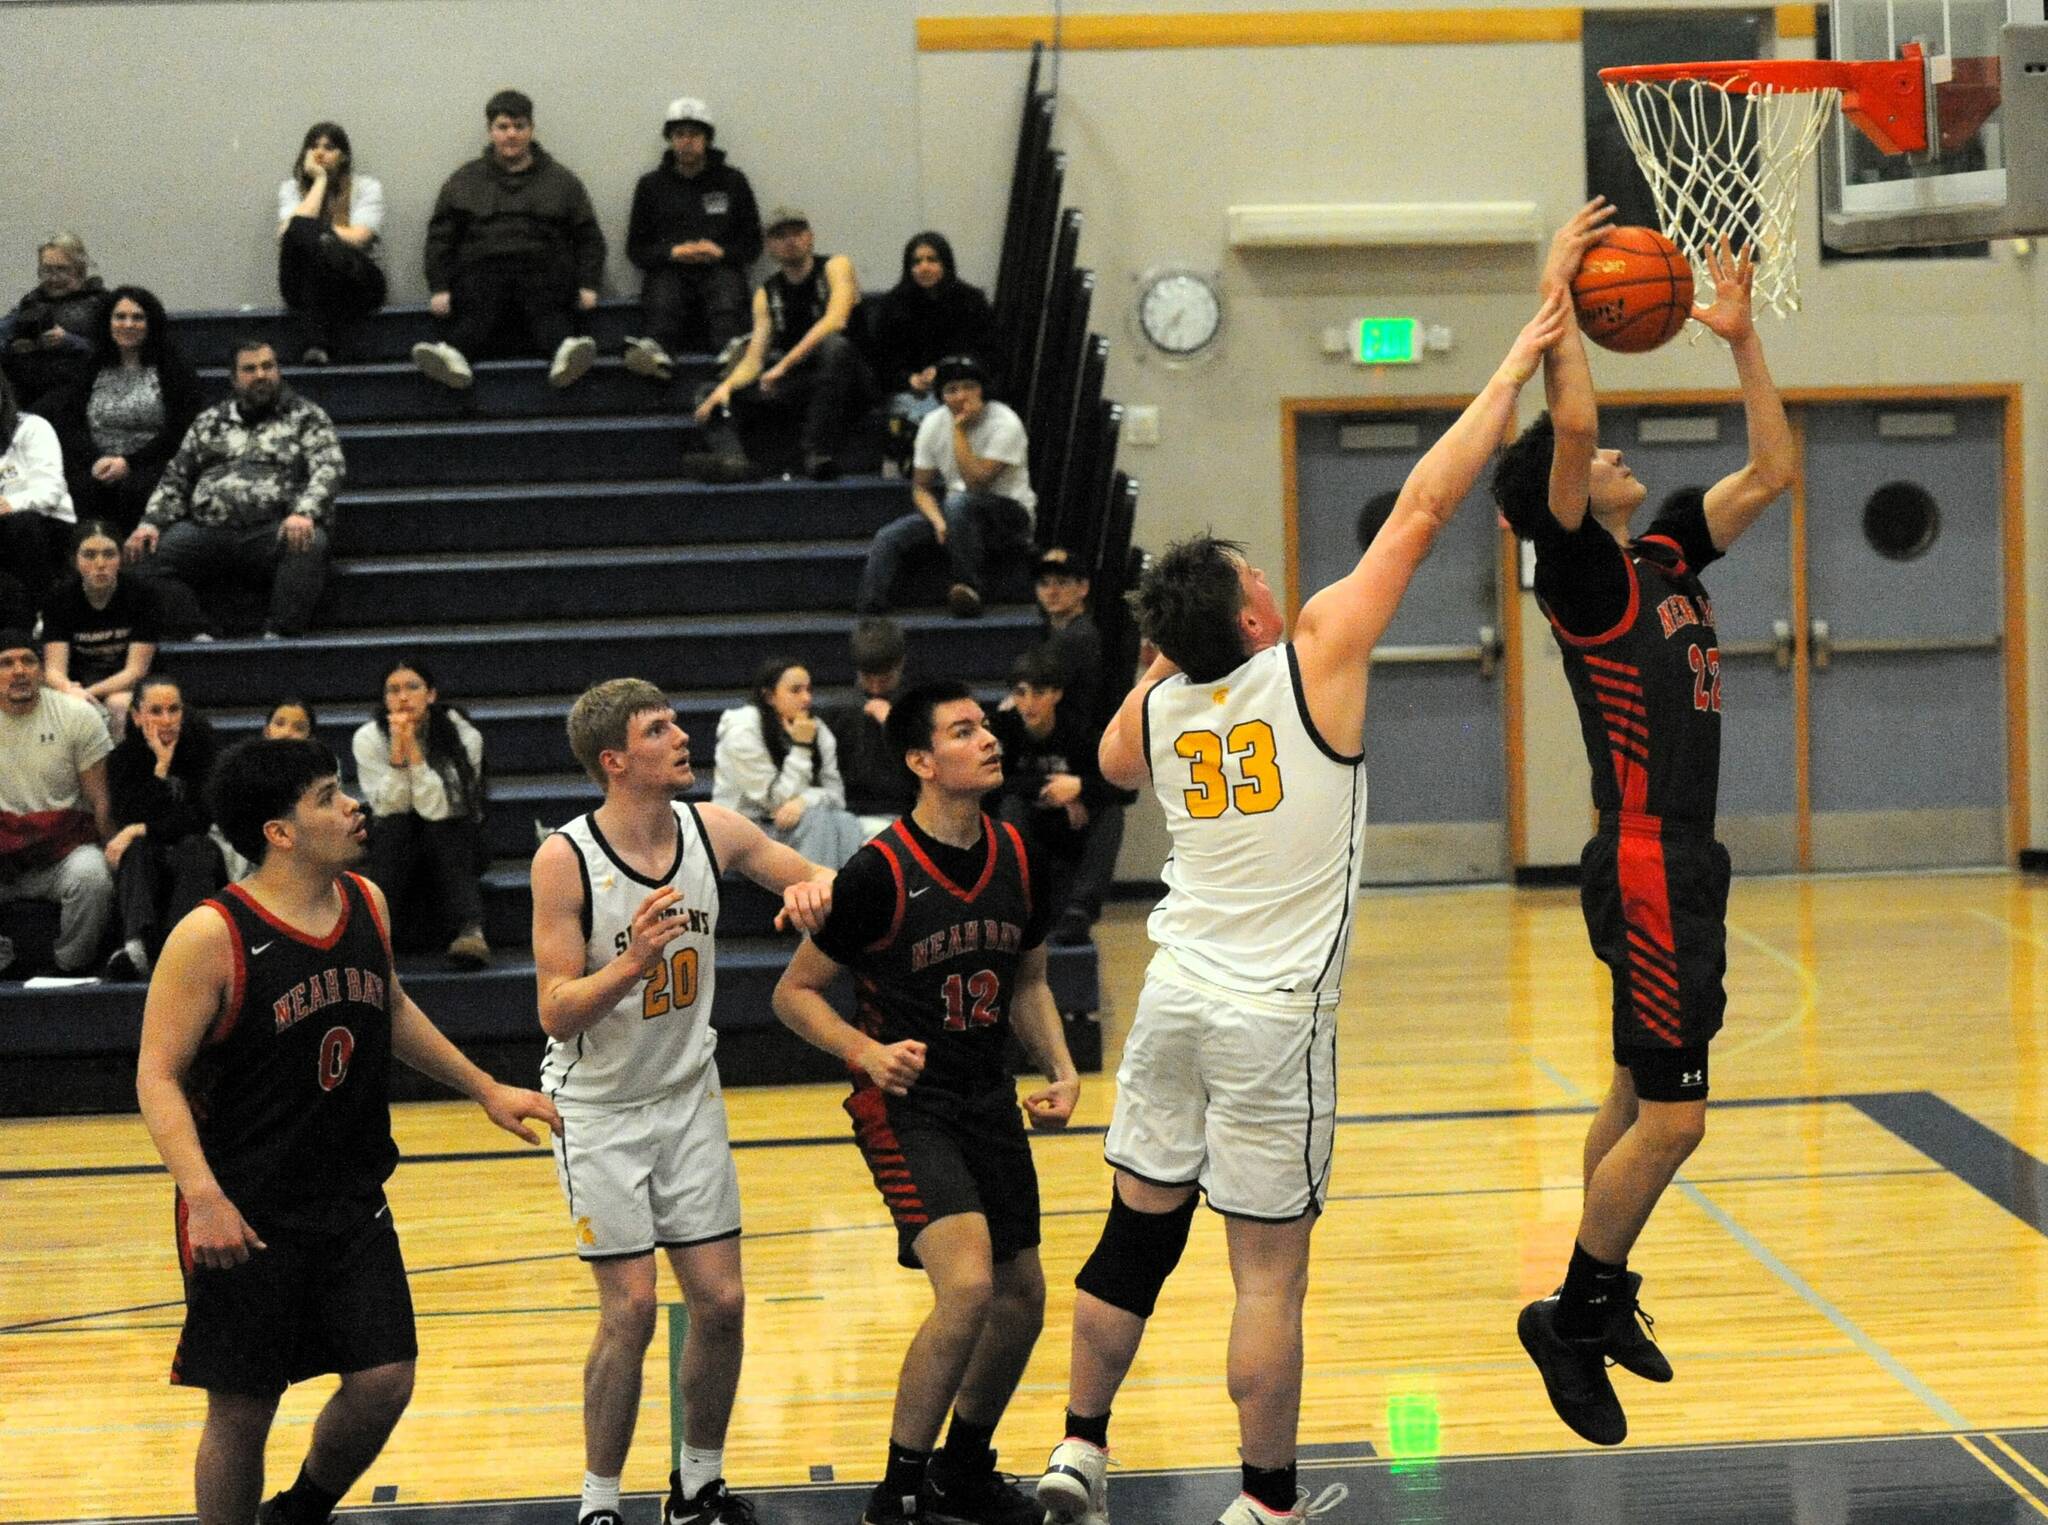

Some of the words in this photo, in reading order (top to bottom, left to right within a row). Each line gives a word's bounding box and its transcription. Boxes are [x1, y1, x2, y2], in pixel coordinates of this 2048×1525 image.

[1688, 643, 1722, 712] 22
[1173, 718, 1284, 819] 33
[911, 919, 979, 972] NEAH
[273, 968, 343, 1034] NEAH
[641, 946, 699, 1020] 20
[941, 968, 1000, 1031] 12
[318, 1026, 354, 1092] 0
